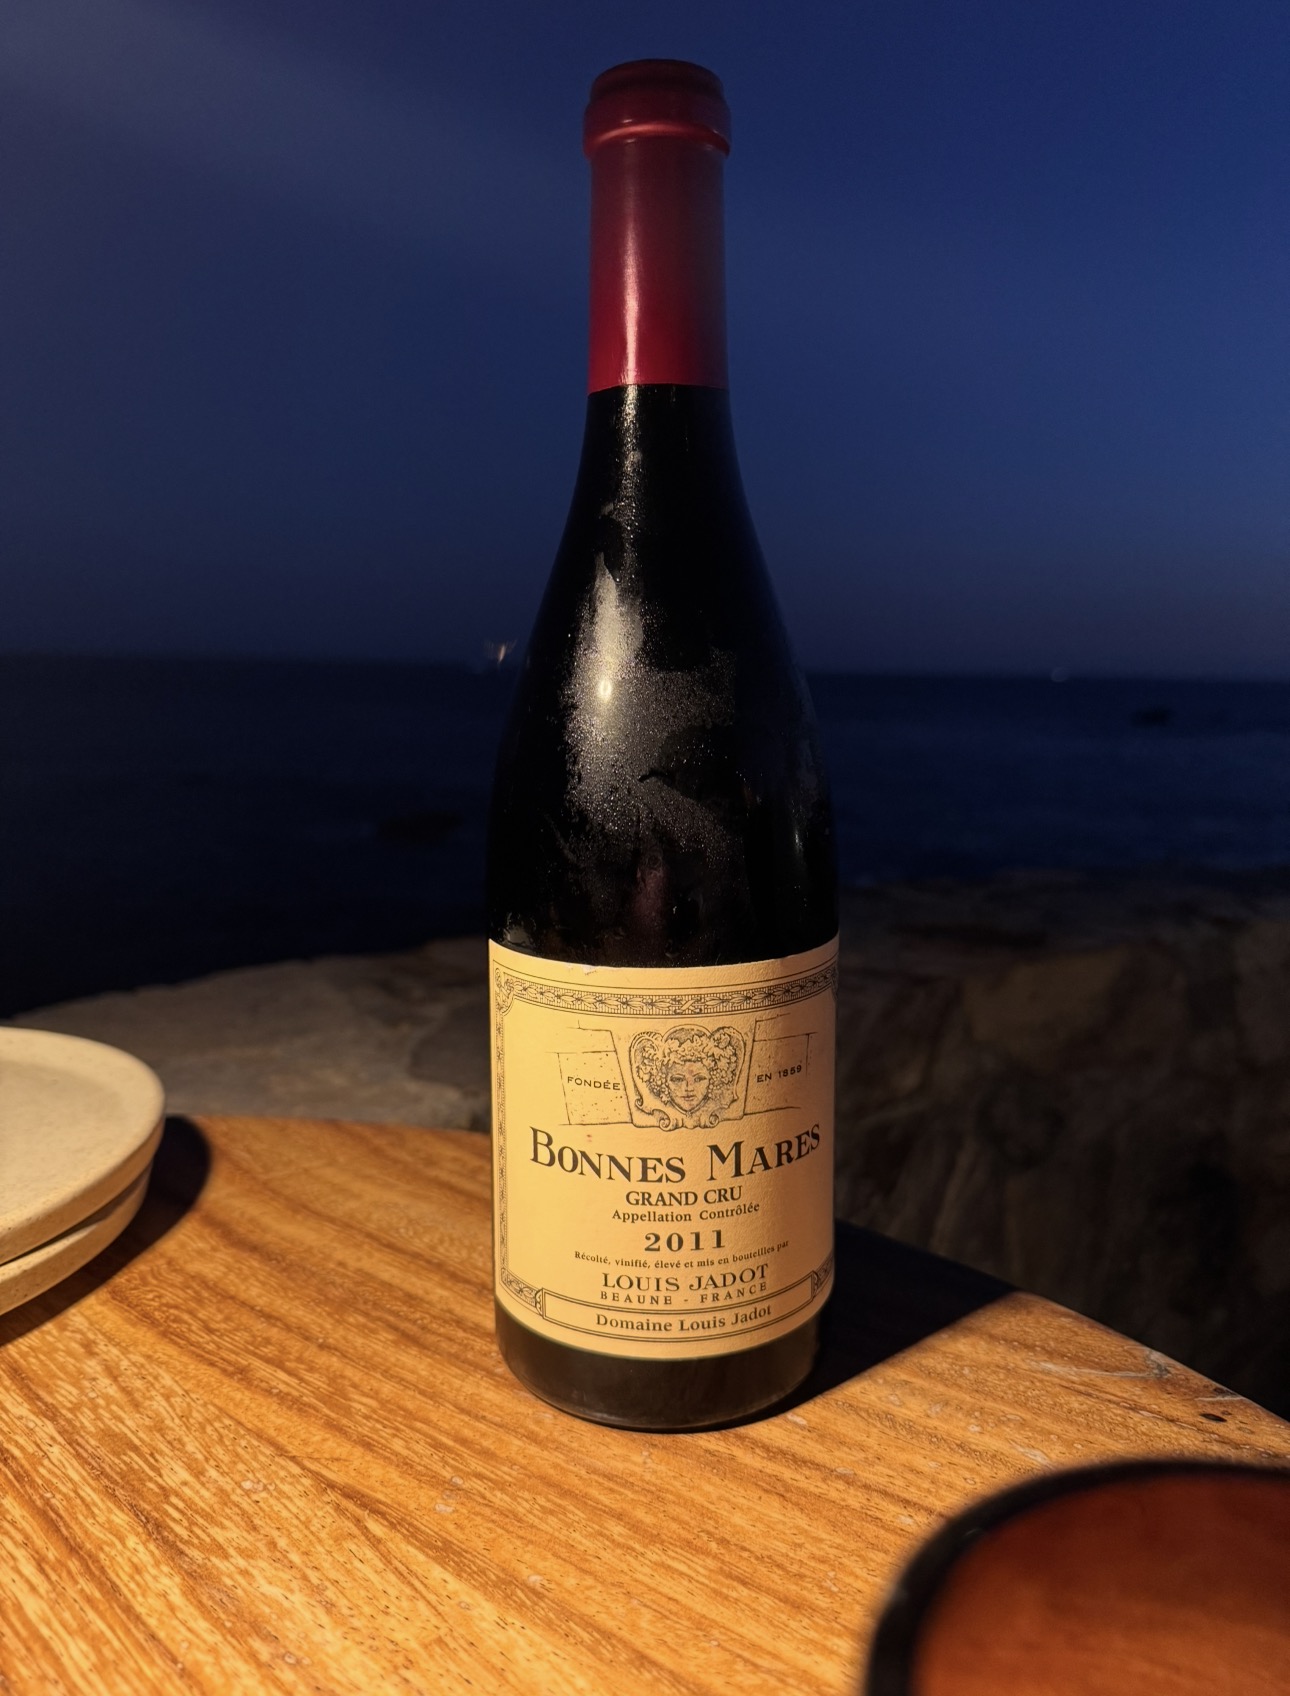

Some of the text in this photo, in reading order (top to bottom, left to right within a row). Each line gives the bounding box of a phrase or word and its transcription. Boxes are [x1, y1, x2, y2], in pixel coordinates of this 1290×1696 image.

[567, 1065, 802, 1091] FONDÉE EN 1859
[530, 1124, 821, 1183] BONNES MARES
[625, 1185, 743, 1206] GRAND CRU
[612, 1202, 760, 1223] Appellation Contrôlée
[644, 1229, 725, 1252] 2011
[574, 1240, 789, 1269] Récolté, vinifié, élevé et mis en bouteilles par
[602, 1263, 769, 1292] LOUIS JADOT
[600, 1290, 672, 1305] BEAUNE
[700, 1282, 767, 1304] FRANCE
[596, 1305, 771, 1332] Domaine Louis Jadot
